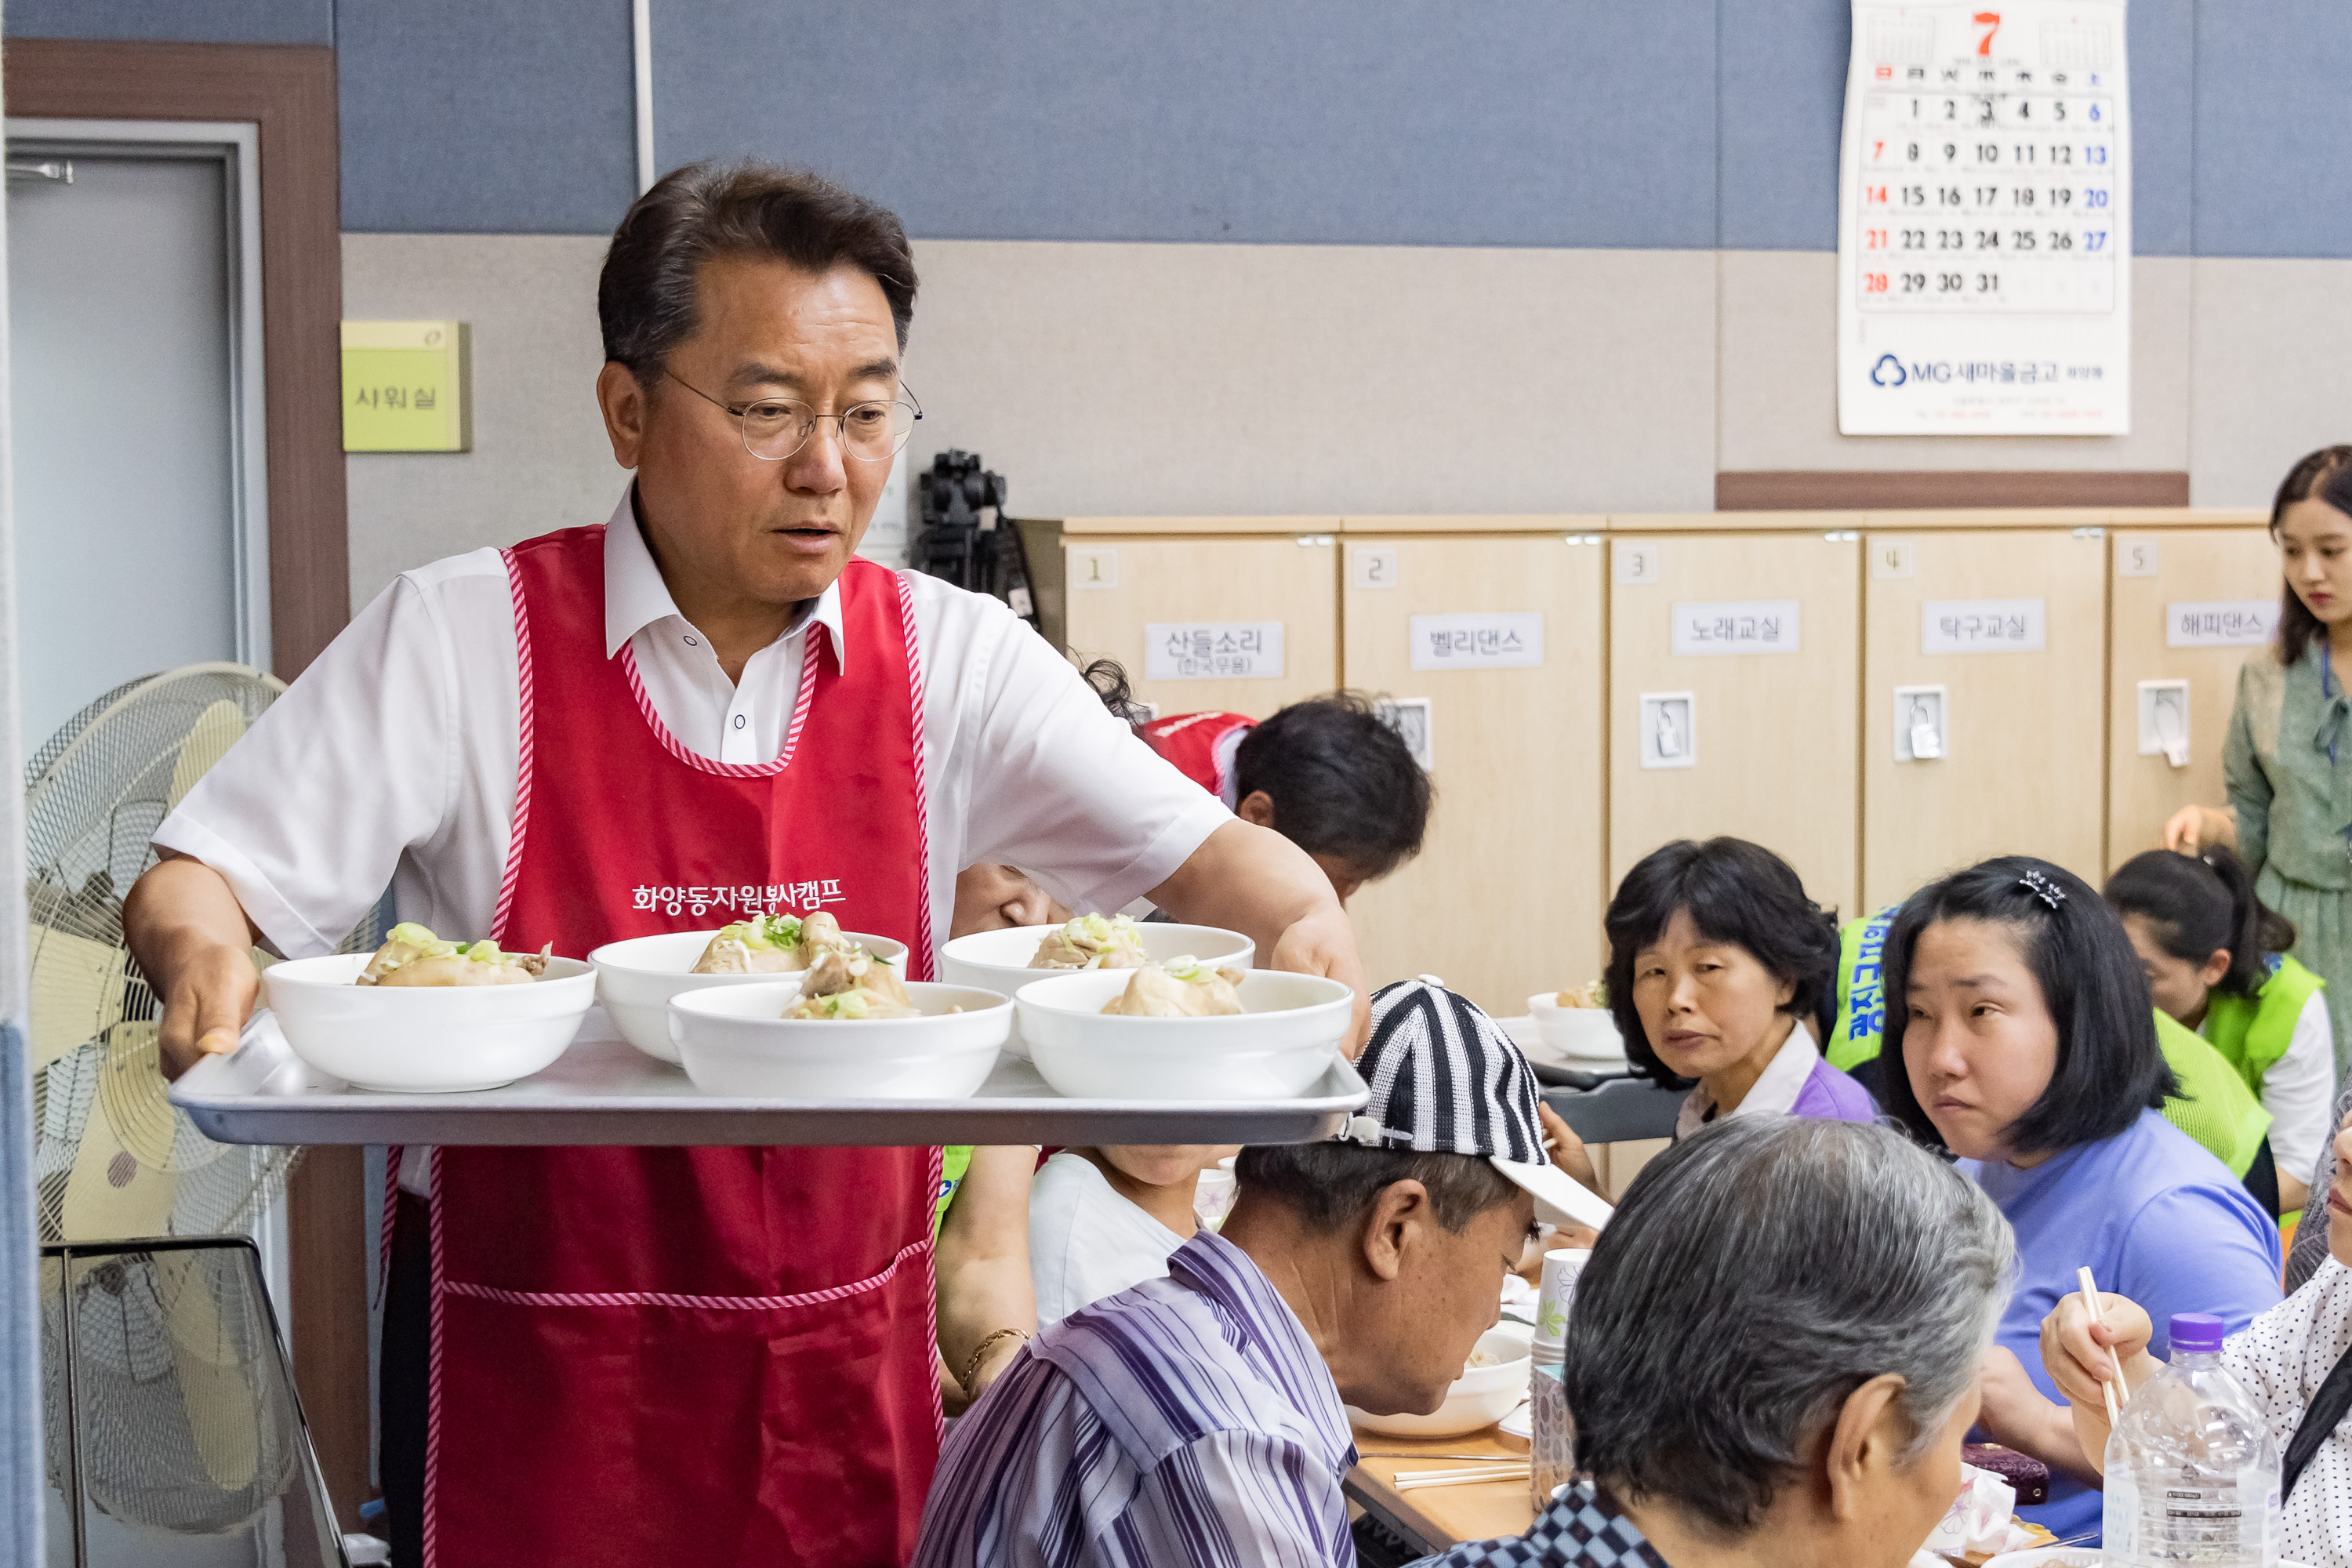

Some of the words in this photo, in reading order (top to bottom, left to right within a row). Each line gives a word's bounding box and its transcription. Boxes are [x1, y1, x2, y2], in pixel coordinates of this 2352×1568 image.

[1973, 12, 2001, 57] 7
[1911, 98, 1918, 118] 1
[1944, 99, 1956, 121] 2
[2018, 100, 2031, 120] 4
[2053, 100, 2067, 122] 5
[2088, 102, 2102, 123] 6
[1874, 140, 1885, 160] 7
[1907, 142, 1920, 162] 8
[1944, 143, 1957, 162] 9
[1976, 143, 1999, 163] 10
[2014, 143, 2034, 163] 11
[2049, 144, 2072, 165] 12
[2085, 145, 2107, 166] 13
[1867, 185, 1889, 204] 14
[1901, 185, 1926, 207] 15
[1938, 187, 1962, 206] 16
[1975, 186, 1998, 205] 17
[2013, 187, 2035, 207] 18
[2049, 187, 2072, 206] 19
[2085, 187, 2109, 209] 20
[1866, 228, 1888, 250] 21
[1901, 229, 1926, 250] 22
[1937, 229, 1964, 250] 23
[1977, 230, 2000, 250] 24
[2012, 230, 2037, 251] 25
[2049, 230, 2074, 251] 26
[2086, 230, 2107, 252] 27
[1864, 271, 1889, 294] 28
[1902, 272, 1927, 293] 29
[1938, 272, 1963, 293] 30
[1976, 273, 1999, 293] 31
[1088, 557, 1102, 583] 1
[1368, 557, 1383, 582] 2
[1632, 554, 1645, 576] 3
[1886, 550, 1900, 570] 4
[2132, 547, 2146, 570] 5
[1690, 616, 1779, 642] 노래교실
[1940, 614, 2025, 641] 탁구교실
[2181, 612, 2263, 637] 해피댄스
[1430, 629, 1523, 657] 벨리댄스
